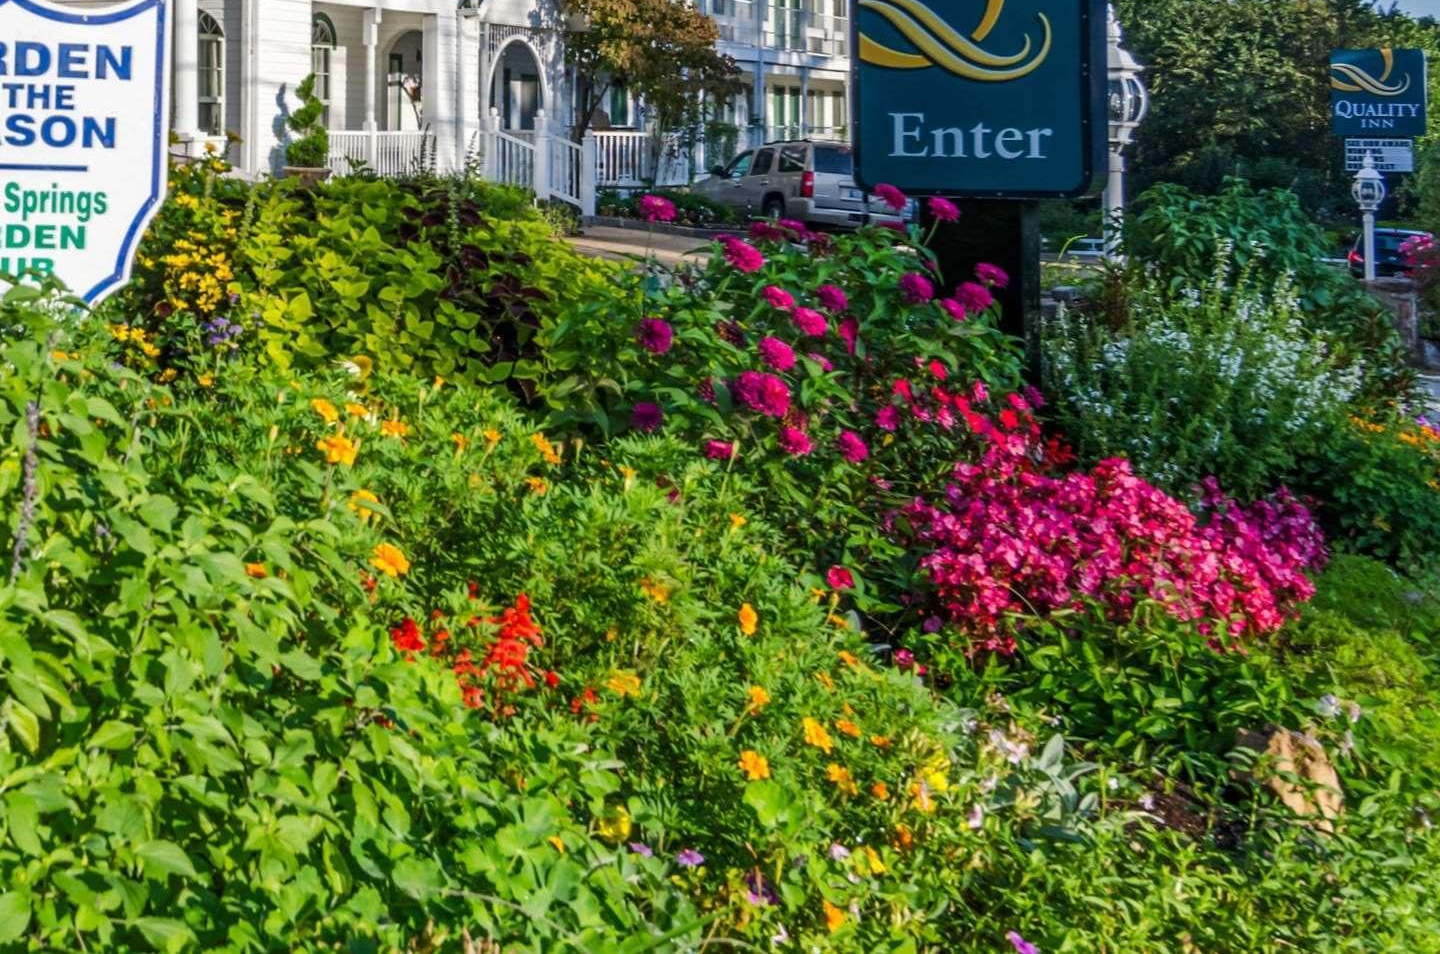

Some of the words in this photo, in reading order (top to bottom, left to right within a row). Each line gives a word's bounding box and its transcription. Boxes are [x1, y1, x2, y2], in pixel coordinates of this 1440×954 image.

[2, 83, 75, 110] THE
[1335, 100, 1420, 119] QUALITY
[888, 112, 1053, 159] Enter
[1361, 119, 1395, 128] INN
[4, 182, 107, 223] Springs
